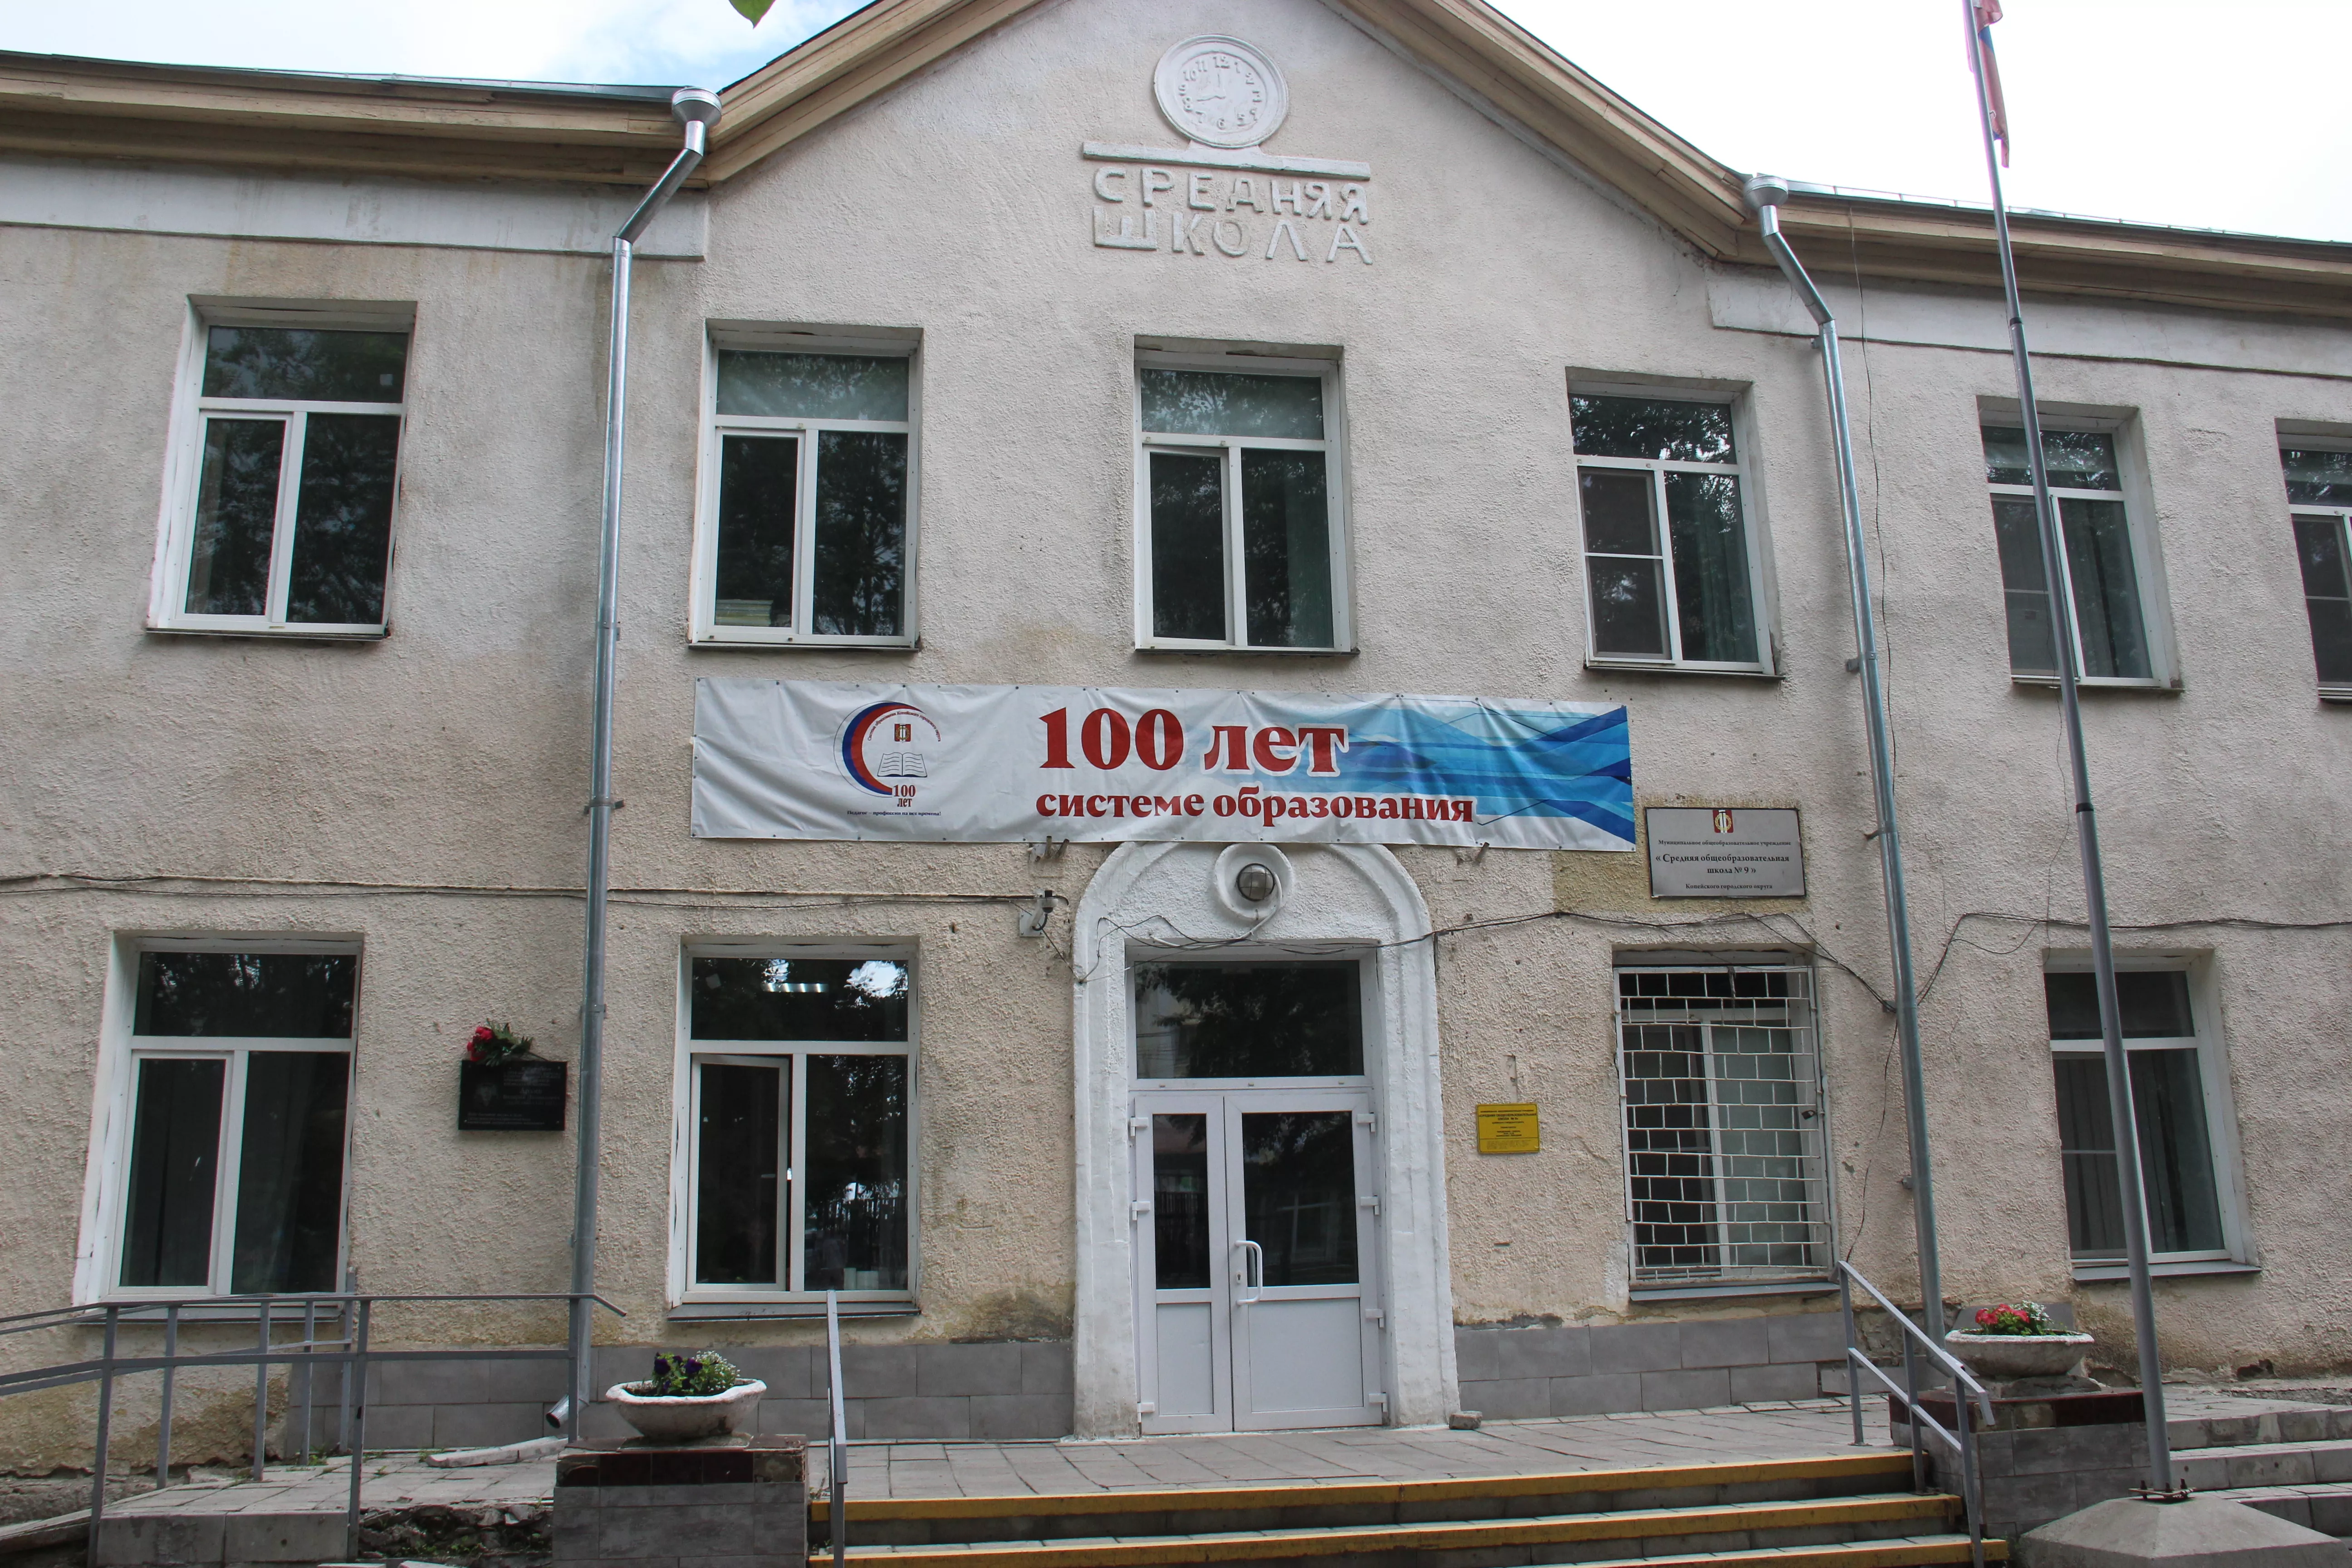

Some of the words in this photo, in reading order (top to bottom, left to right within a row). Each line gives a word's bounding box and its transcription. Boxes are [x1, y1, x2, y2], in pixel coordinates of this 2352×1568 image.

[1195, 59, 1208, 72] 11
[1213, 55, 1230, 69] 12
[1183, 69, 1198, 81] 10
[1245, 72, 1254, 84] 2
[1178, 83, 1186, 96] 9
[1182, 97, 1193, 113] 8
[1195, 110, 1206, 123] 7
[1217, 117, 1226, 130] 6
[1093, 166, 1369, 225] СРЕДНЯЯ
[1093, 206, 1373, 265] ШКОЛА
[1039, 706, 1184, 771] 100
[1204, 725, 1344, 773] лет
[893, 784, 916, 797] 100
[897, 798, 912, 807] лет
[1035, 794, 1205, 818] системе
[1213, 785, 1474, 828] образования
[1662, 853, 1699, 863] Средняя
[1700, 854, 1789, 863] общеобразовательная
